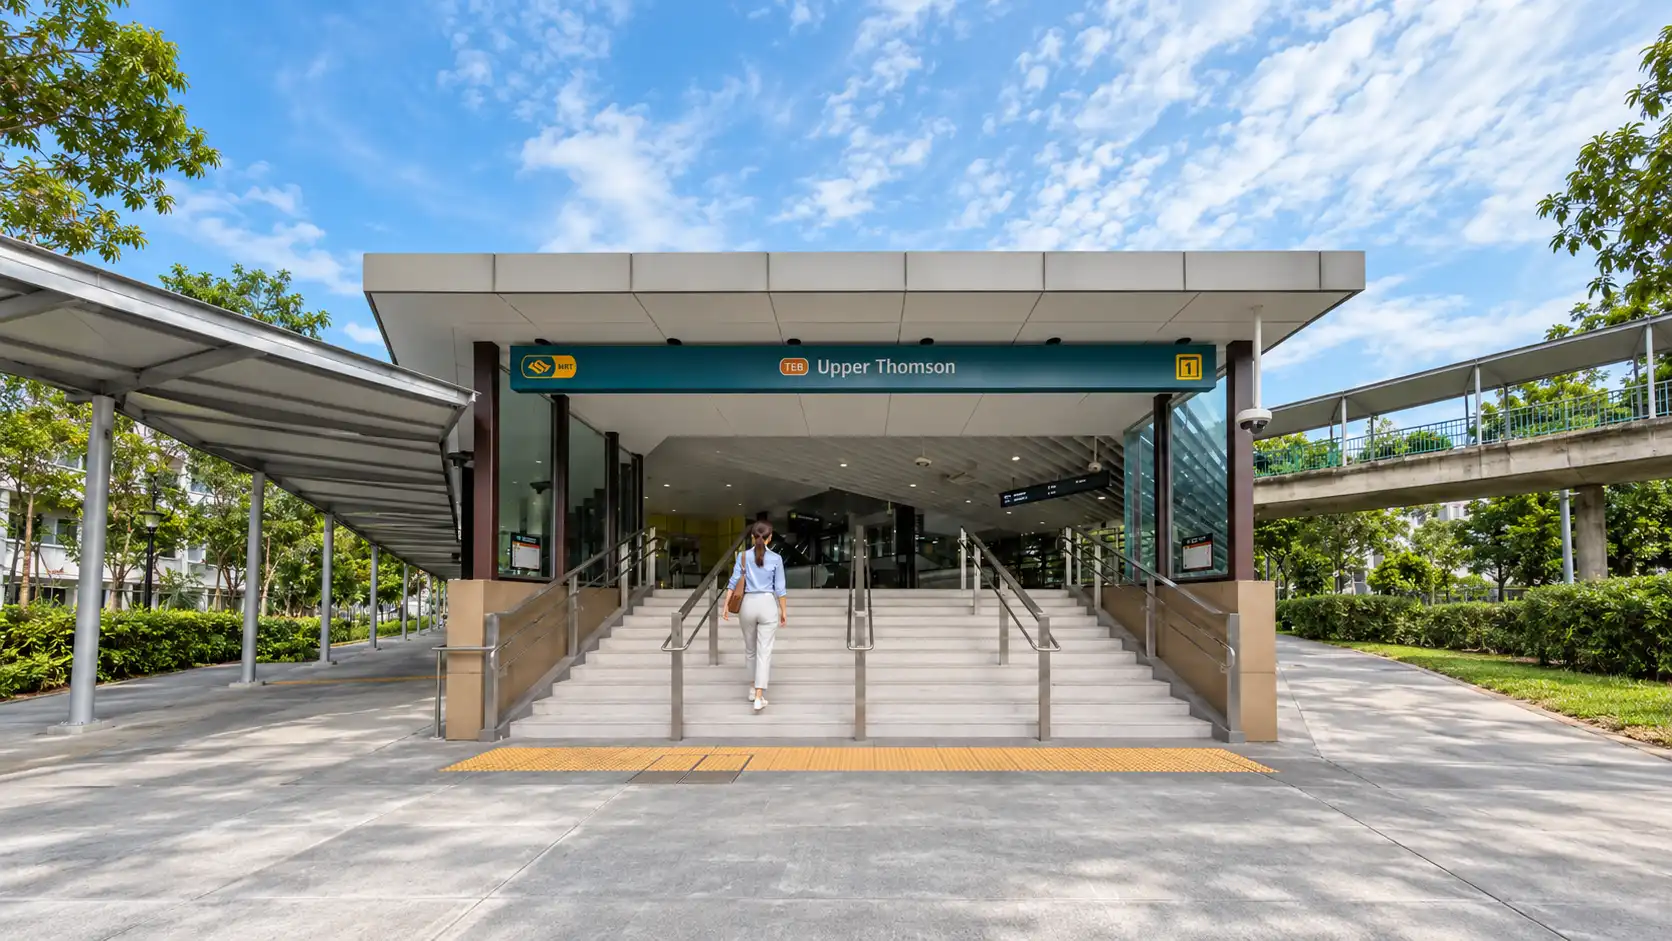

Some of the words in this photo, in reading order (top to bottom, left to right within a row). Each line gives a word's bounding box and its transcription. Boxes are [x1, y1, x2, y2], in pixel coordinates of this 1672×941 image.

[817, 359, 870, 378] Upper
[875, 358, 956, 374] Thomson
[1184, 362, 1191, 375] 1
